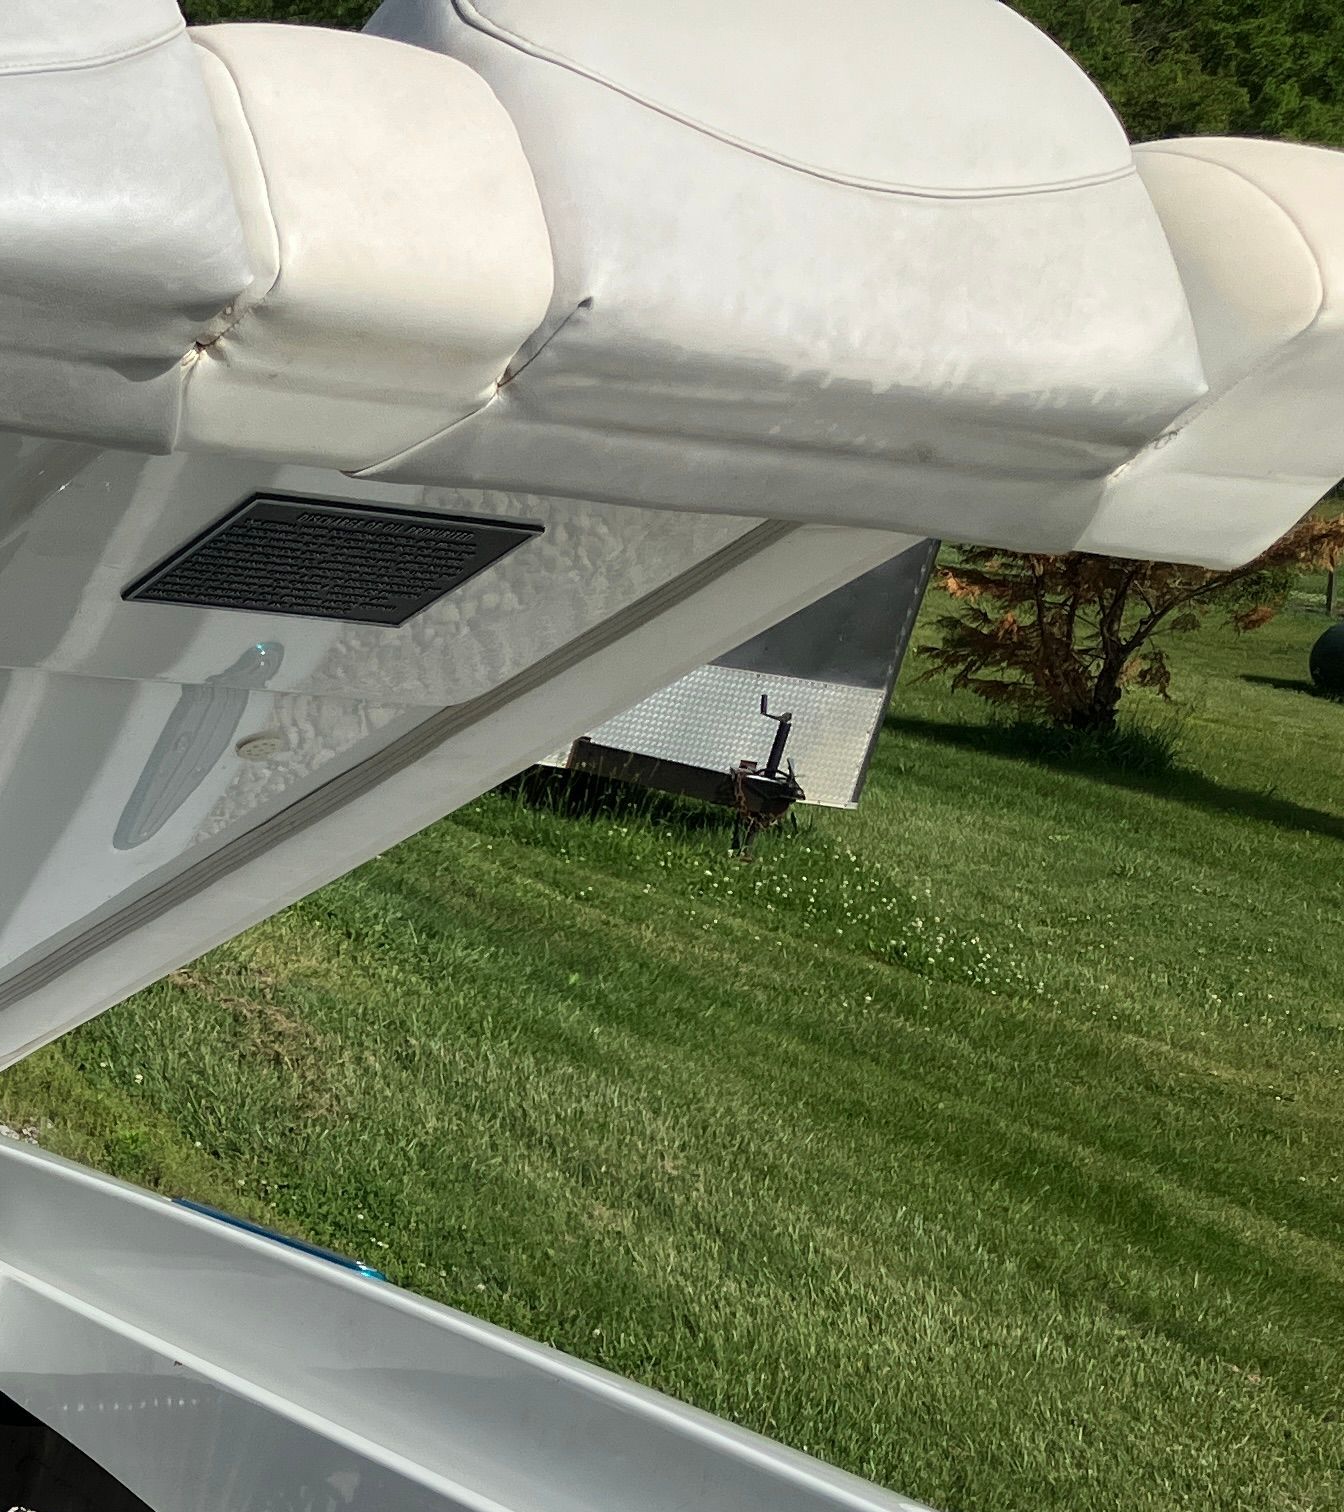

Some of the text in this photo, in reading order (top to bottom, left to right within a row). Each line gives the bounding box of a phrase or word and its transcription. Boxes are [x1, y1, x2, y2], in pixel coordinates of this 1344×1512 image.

[297, 511, 363, 529] DISCHARGE
[383, 522, 405, 533] OIL
[407, 526, 474, 541] PROHIBITED
